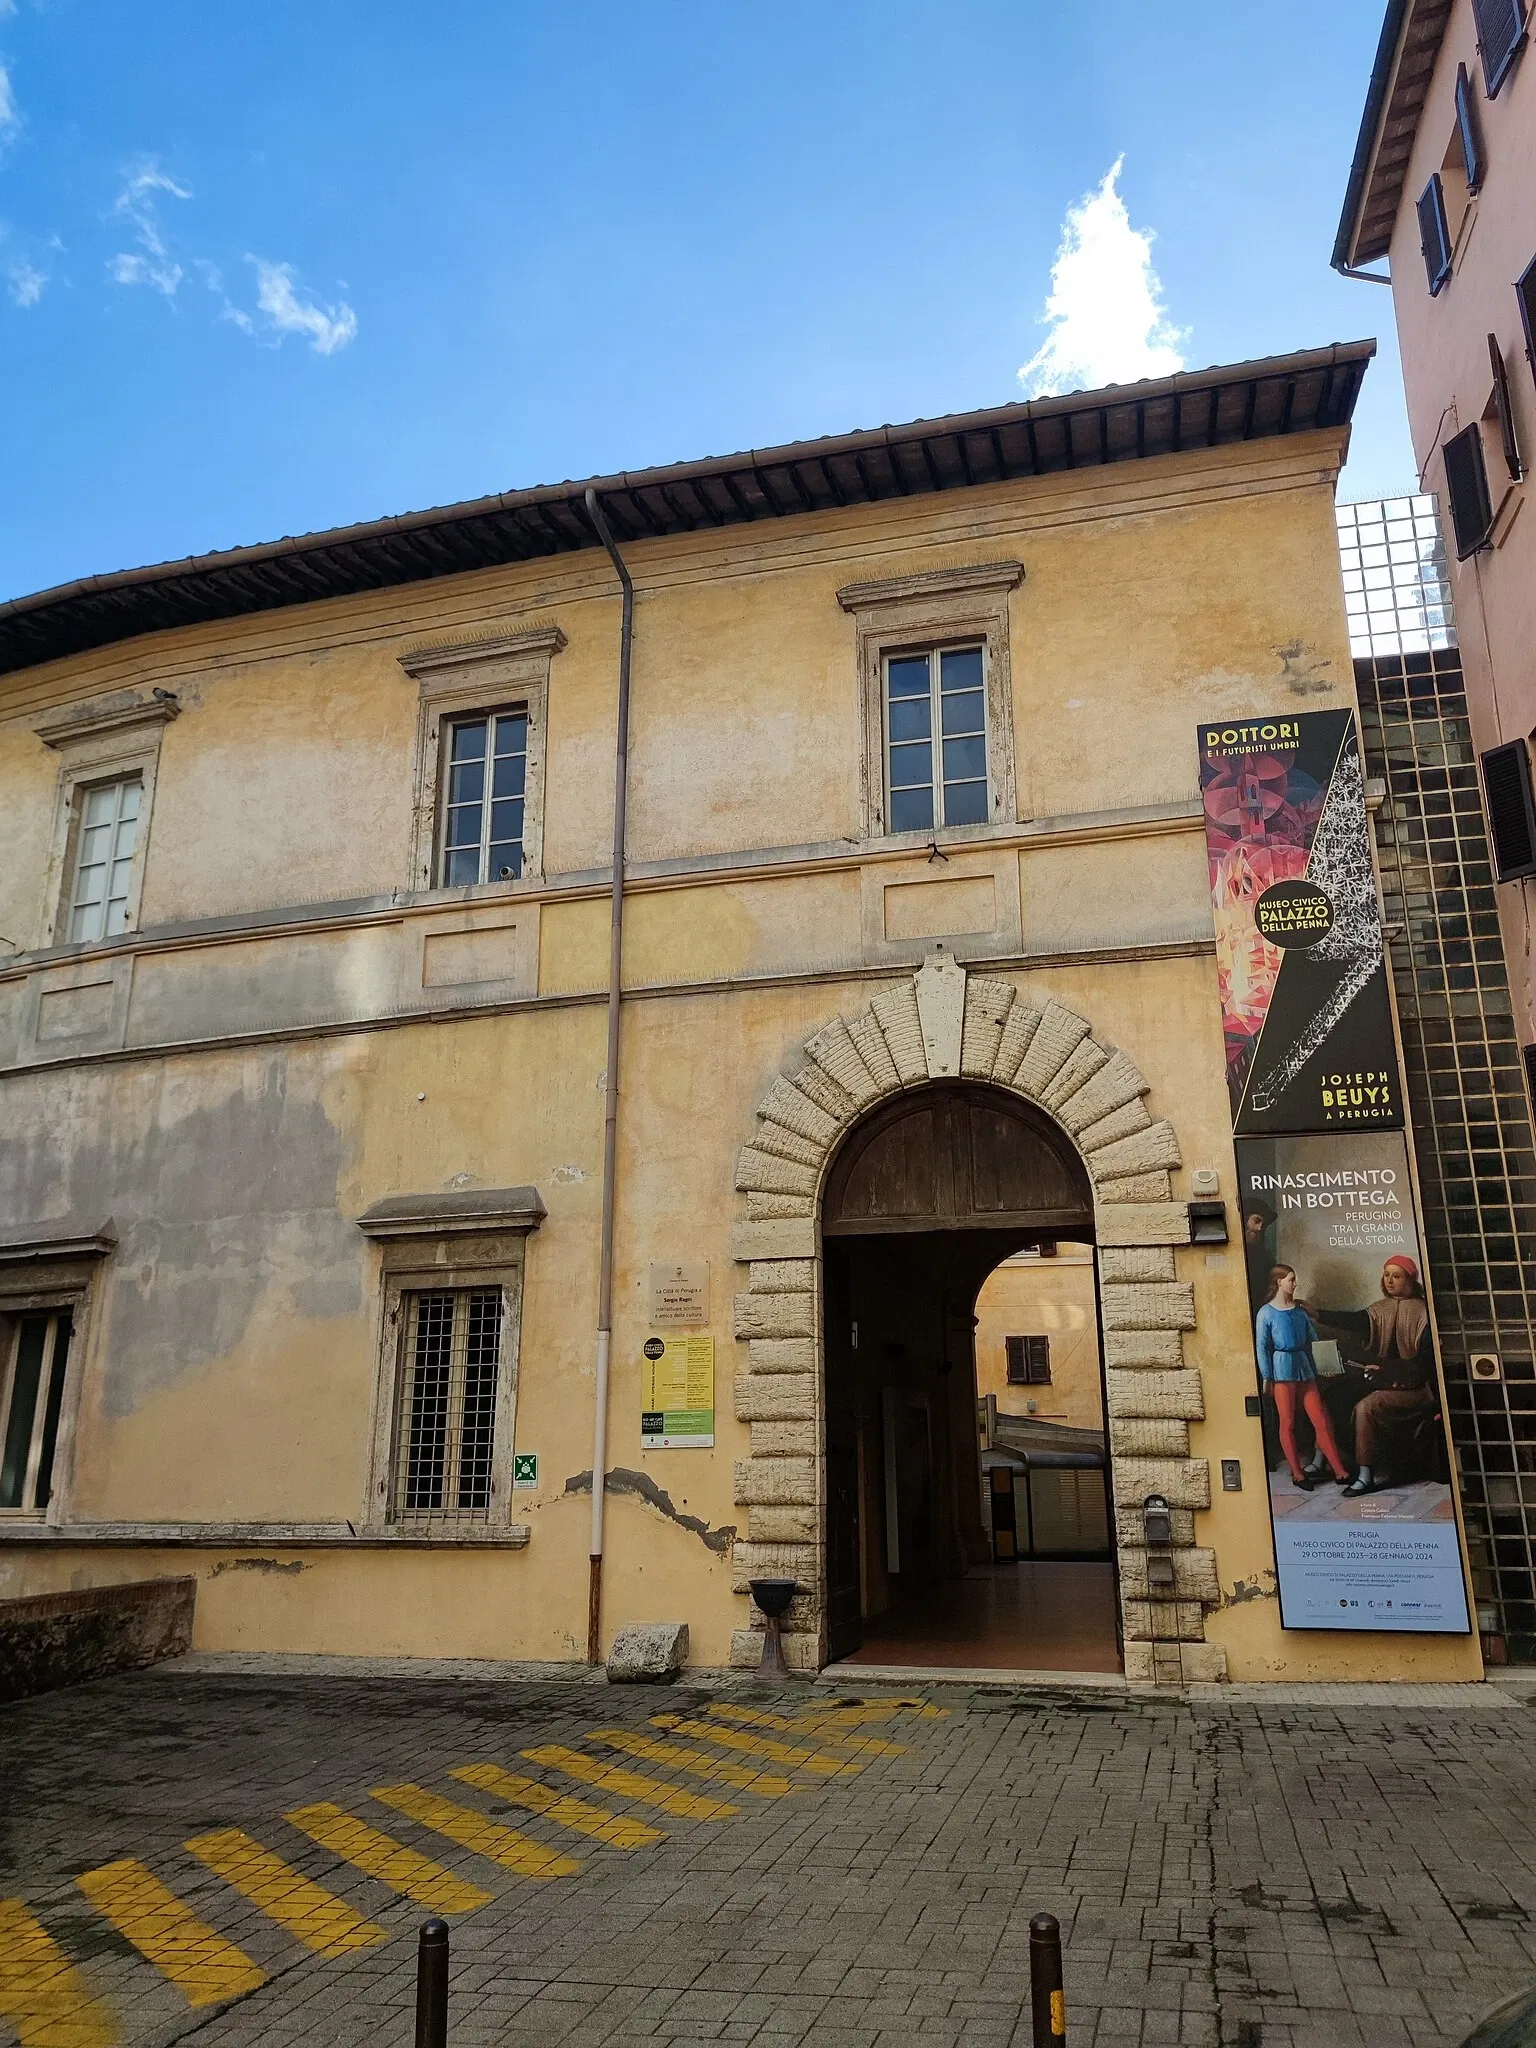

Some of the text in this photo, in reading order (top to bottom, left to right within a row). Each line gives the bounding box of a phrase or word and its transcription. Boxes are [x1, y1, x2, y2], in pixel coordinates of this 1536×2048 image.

[1207, 722, 1300, 747] DOTTORI
[1207, 750, 1213, 758] E
[1222, 744, 1267, 756] FUTURISTI
[1270, 740, 1300, 751] UMBRI
[1259, 896, 1327, 910] MUSEO CIVICO
[1260, 905, 1329, 923] PALAZZO
[1261, 918, 1330, 933] DELLA PENNA
[1320, 1071, 1389, 1087] JOSEPH
[1322, 1086, 1390, 1107] BEUYS
[1325, 1108, 1393, 1120] A PERUGIA
[1250, 1168, 1397, 1190] RINASCIMENTO
[1282, 1189, 1400, 1209] IN BOTTEGA
[1345, 1210, 1401, 1222] PERUGINO
[1332, 1222, 1404, 1234] TRA I GRANDI
[1329, 1234, 1405, 1246] DELLA STORIA
[1348, 1531, 1380, 1539] PERUGIA
[1293, 1540, 1319, 1548] MUSEO
[1319, 1541, 1346, 1549] CIVICO
[1346, 1541, 1354, 1549] DI
[1355, 1541, 1389, 1549] PALAZZO
[1414, 1542, 1440, 1550] PENNA
[1311, 1551, 1345, 1559] OTTOBRE
[1379, 1552, 1414, 1560] GENNAIO
[1415, 1552, 1433, 1560] 2024
